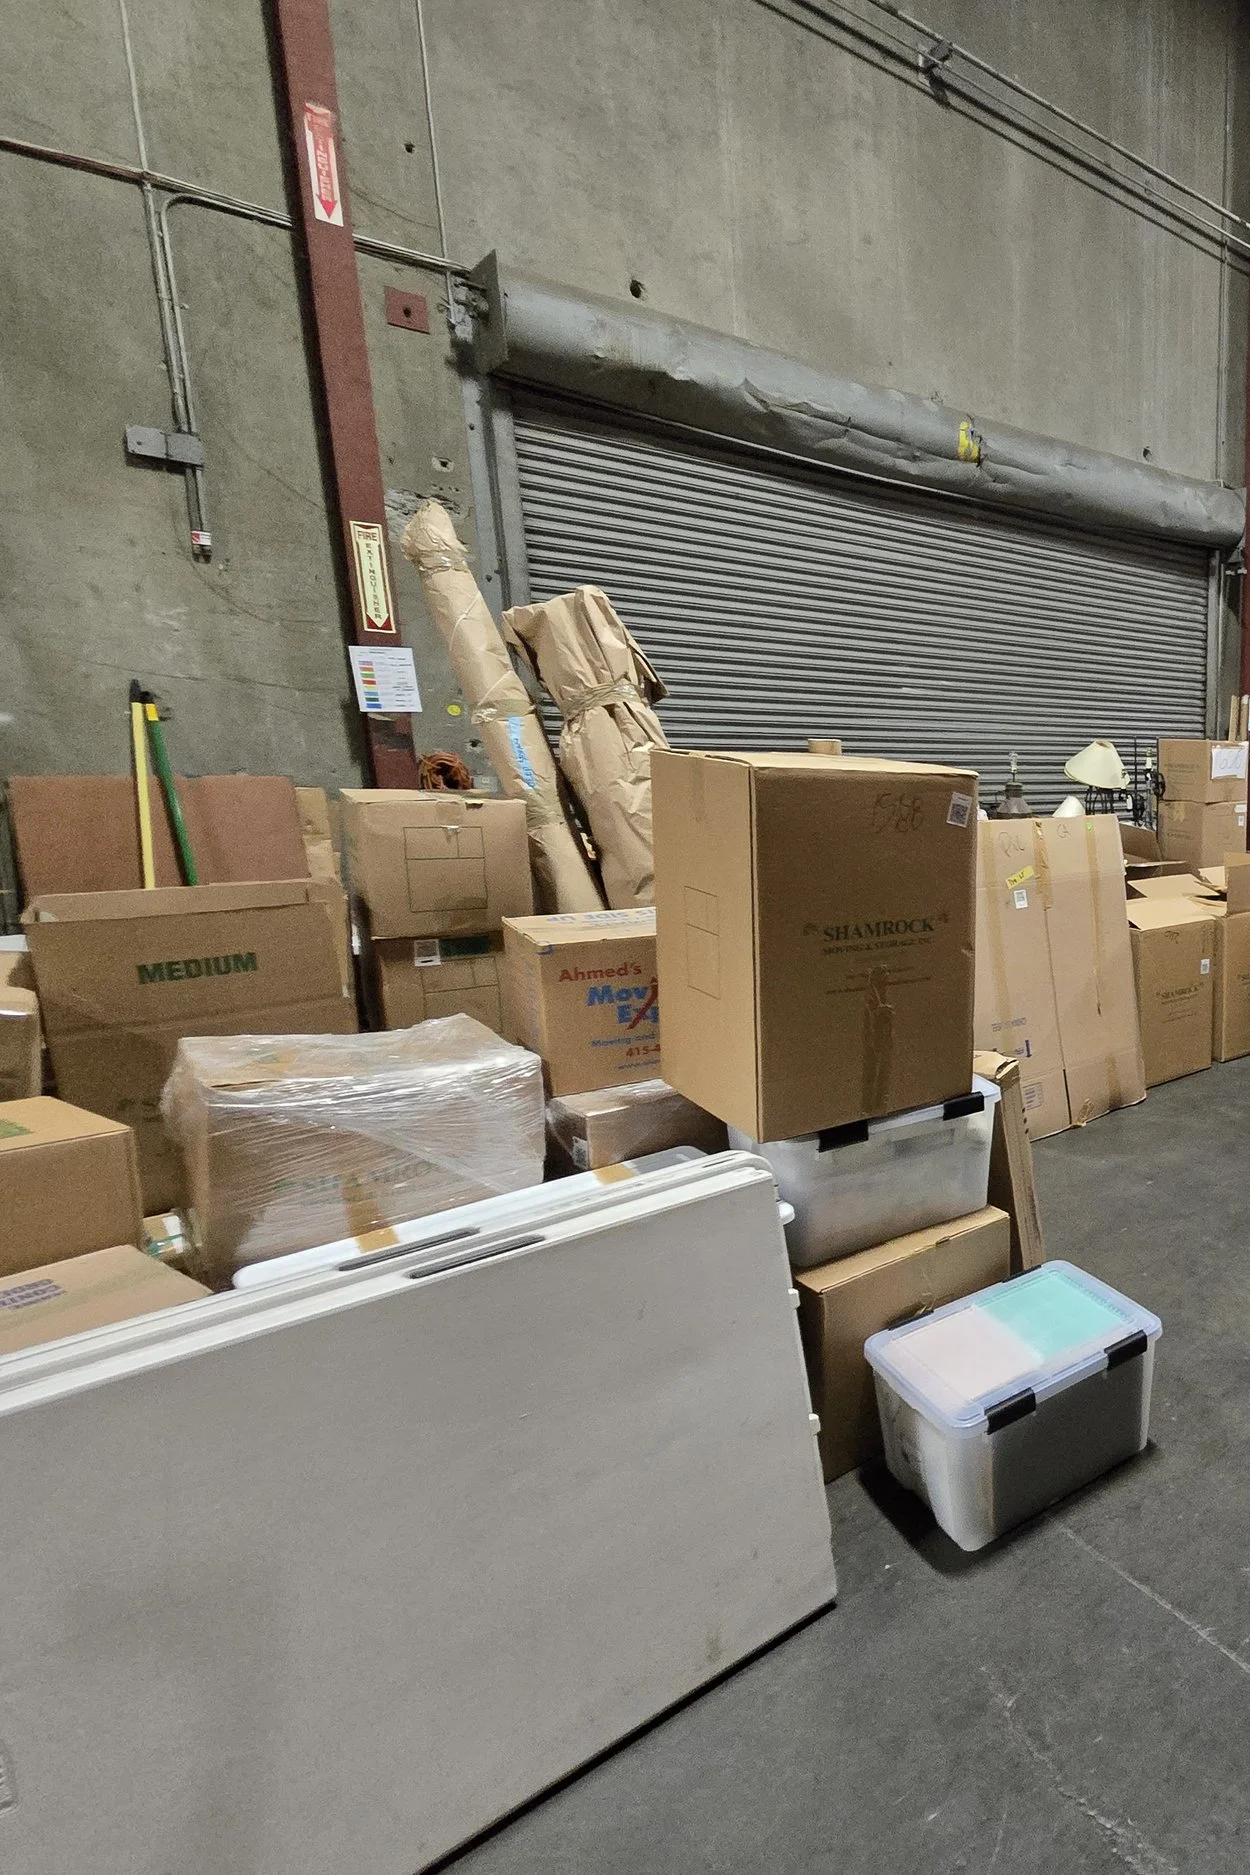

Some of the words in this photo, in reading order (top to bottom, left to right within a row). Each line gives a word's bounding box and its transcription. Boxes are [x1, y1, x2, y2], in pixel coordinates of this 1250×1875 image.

[357, 530, 377, 541] FIRE
[365, 542, 382, 619] EXTINGUISHER
[823, 918, 934, 942] SHAMROCK
[136, 951, 258, 985] MEDIUM
[558, 962, 642, 982] Ahmed's
[586, 984, 649, 1006] Mov
